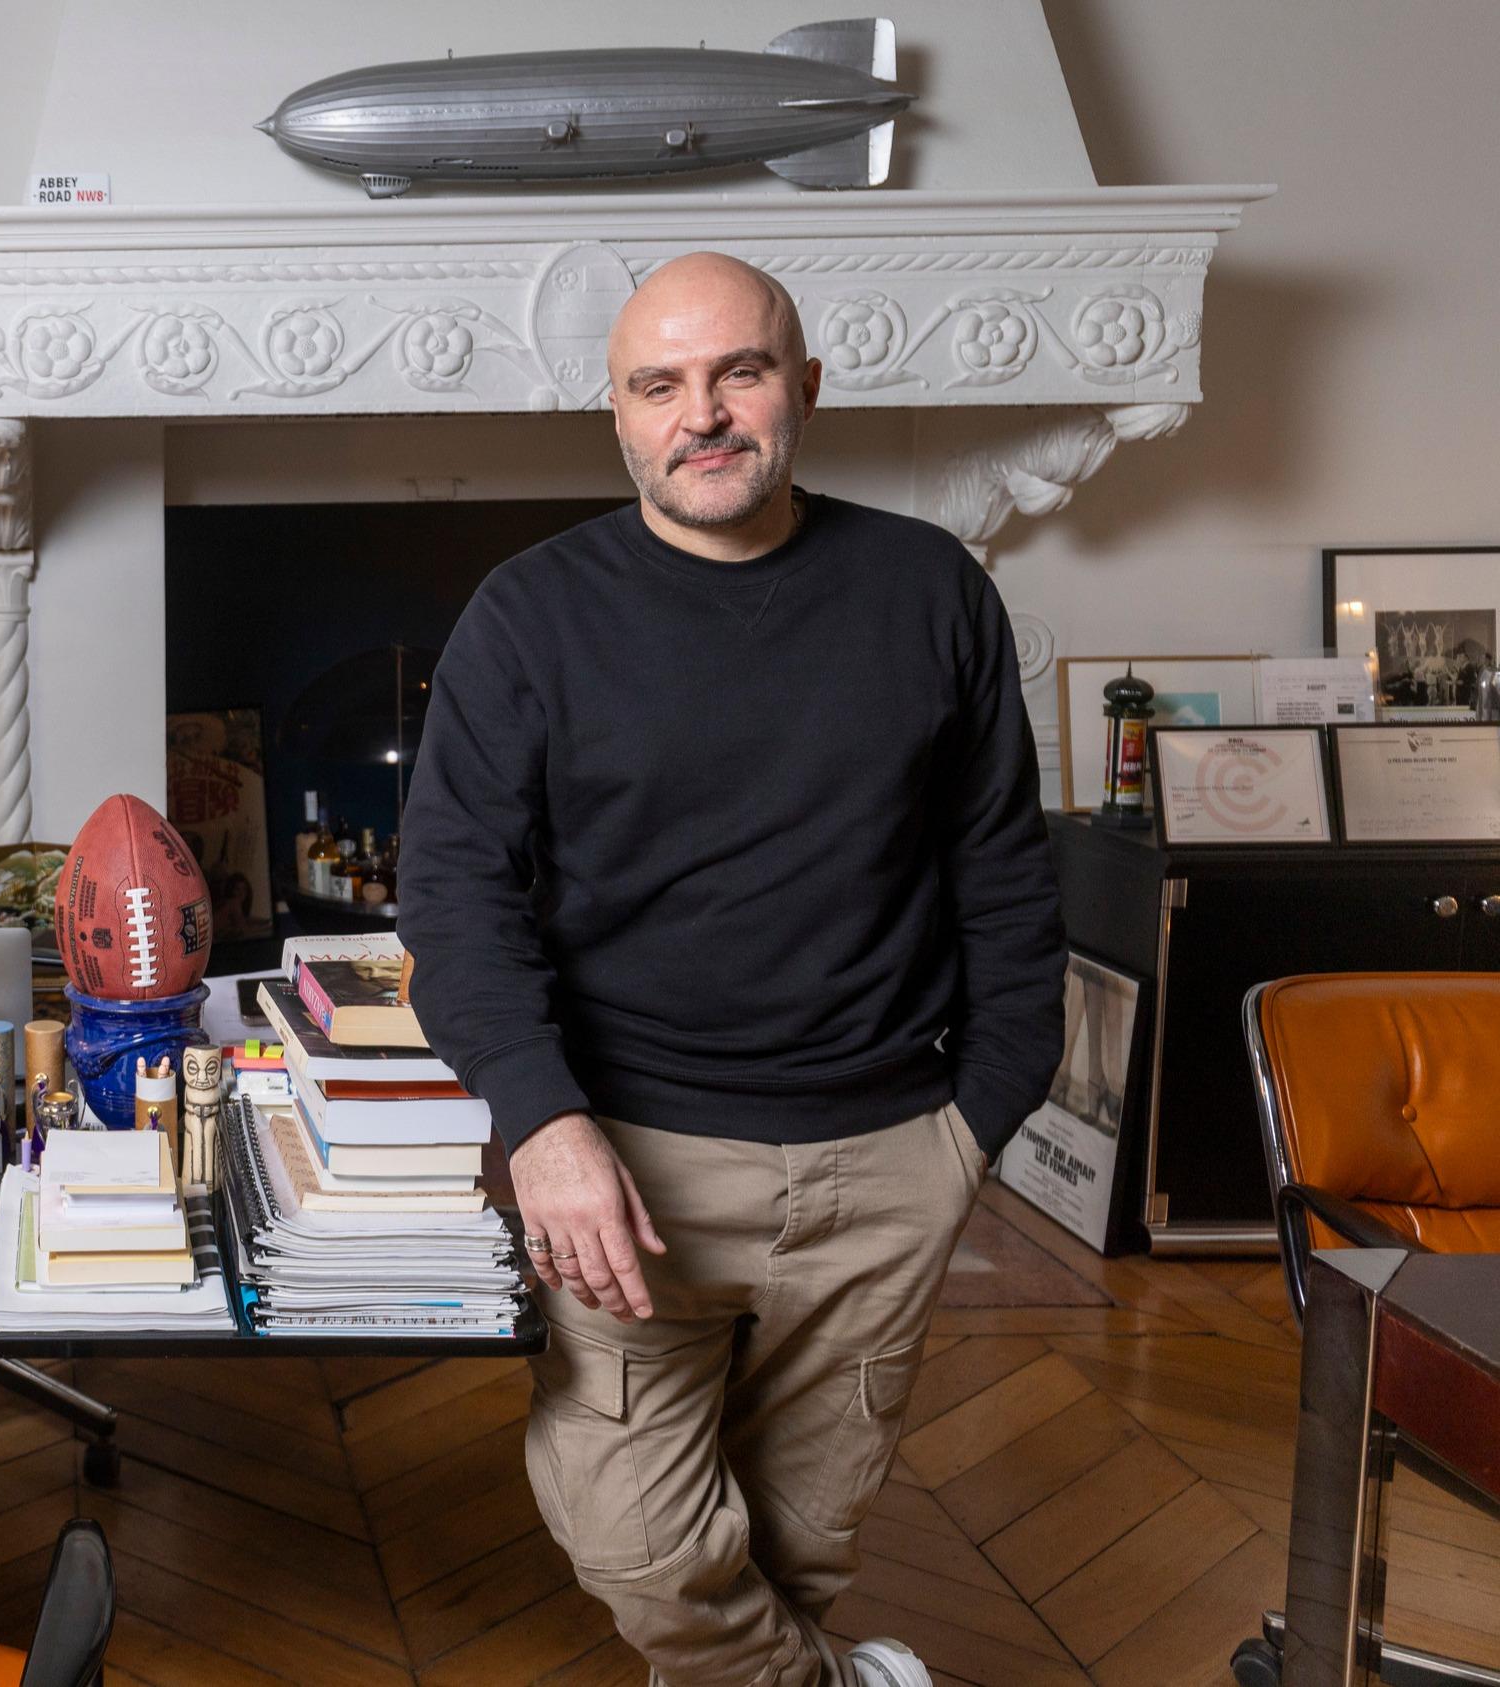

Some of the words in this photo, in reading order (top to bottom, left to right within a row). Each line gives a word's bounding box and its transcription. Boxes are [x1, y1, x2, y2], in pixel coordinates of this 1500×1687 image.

[39, 177, 78, 189] ABBEY
[39, 190, 72, 203] ROAD
[76, 190, 104, 202] NW8
[196, 902, 211, 949] NFL
[1035, 1146, 1049, 1167] LES
[1049, 1157, 1079, 1187] FEMMES
[1053, 1143, 1067, 1163] QUI
[1067, 1154, 1097, 1184] AIMAIT
